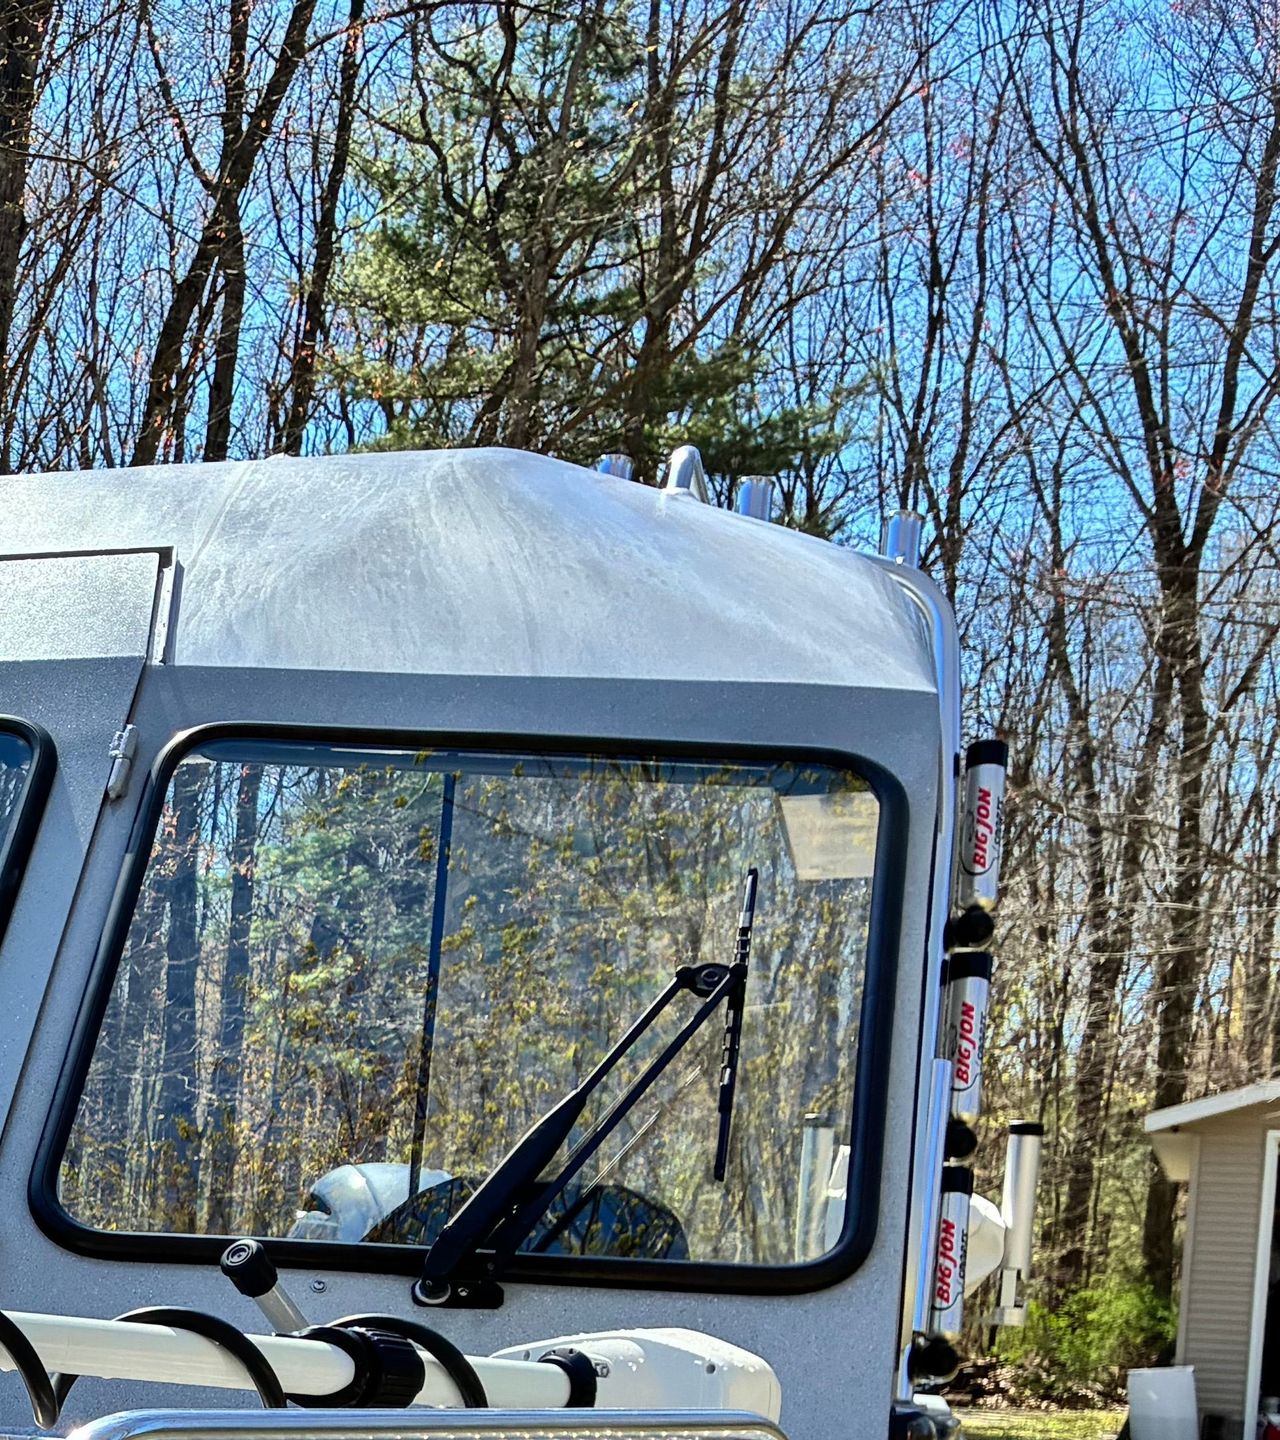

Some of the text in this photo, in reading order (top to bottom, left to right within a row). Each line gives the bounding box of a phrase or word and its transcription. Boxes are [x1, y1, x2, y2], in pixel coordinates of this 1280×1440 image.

[973, 786, 993, 869] BIG JON
[956, 1001, 976, 1084] BIG JON
[937, 1218, 957, 1304] BIG JON
